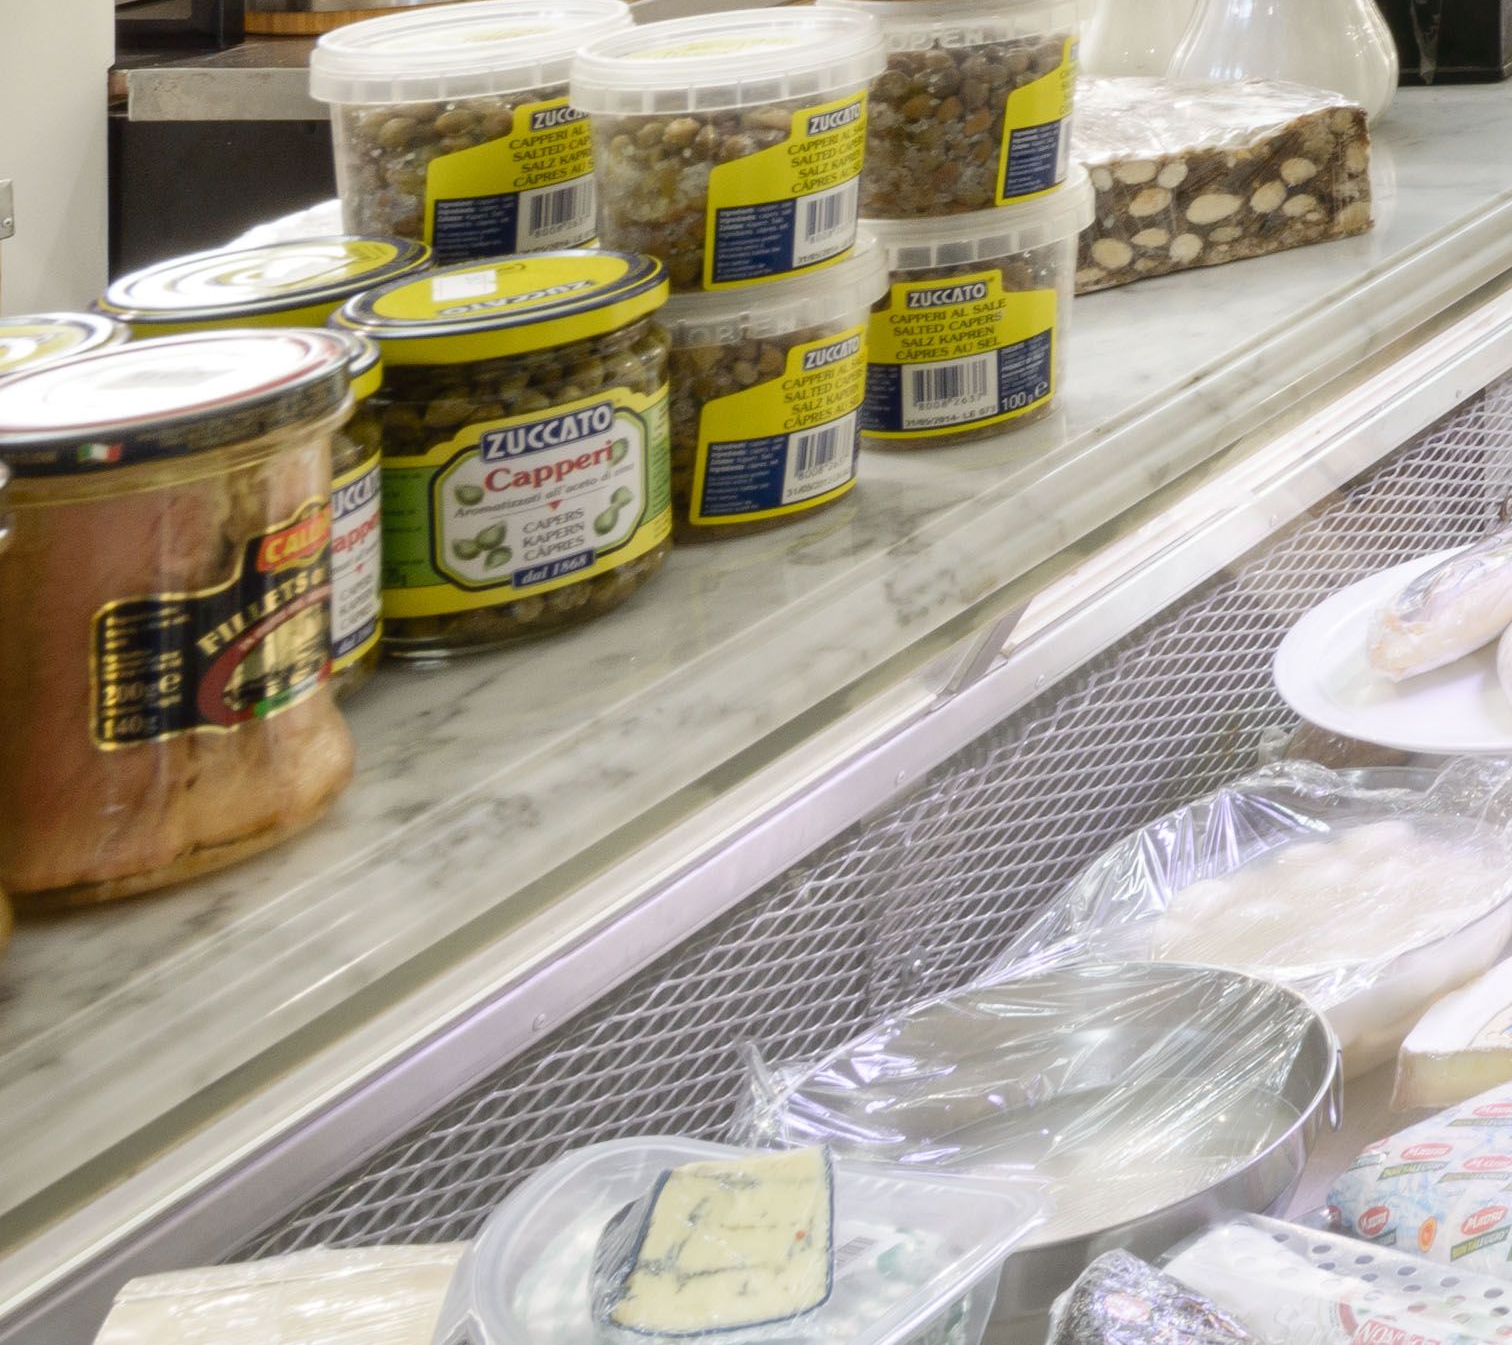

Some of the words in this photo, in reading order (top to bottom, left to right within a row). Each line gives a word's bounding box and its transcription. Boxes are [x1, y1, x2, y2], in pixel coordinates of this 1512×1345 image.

[809, 102, 861, 135] ZUCCATO
[509, 129, 568, 150] CAPPERI
[513, 143, 565, 162] SALTED
[569, 136, 592, 150] CAP
[788, 133, 838, 156] CAPPERI
[522, 159, 555, 173] SALZ
[791, 149, 836, 168] SALTED
[909, 283, 986, 308] ZUCCATO
[890, 310, 947, 324] CAPPERI
[951, 306, 969, 318] AL
[973, 298, 1007, 314] SALE
[893, 322, 945, 337] SALTED
[949, 313, 1002, 331] CAPERS
[902, 335, 936, 348] SALZ
[940, 327, 995, 344] KAPREN
[953, 343, 973, 355] AU
[976, 337, 1000, 350] SEL
[805, 336, 860, 370] ZUCCATO
[782, 370, 835, 391] CAPPERI
[784, 383, 832, 404] SALTED
[485, 404, 613, 461] ZUCCATO
[484, 439, 614, 493] Capperi
[522, 507, 585, 534] CAPERS
[522, 522, 585, 548] KAPERN
